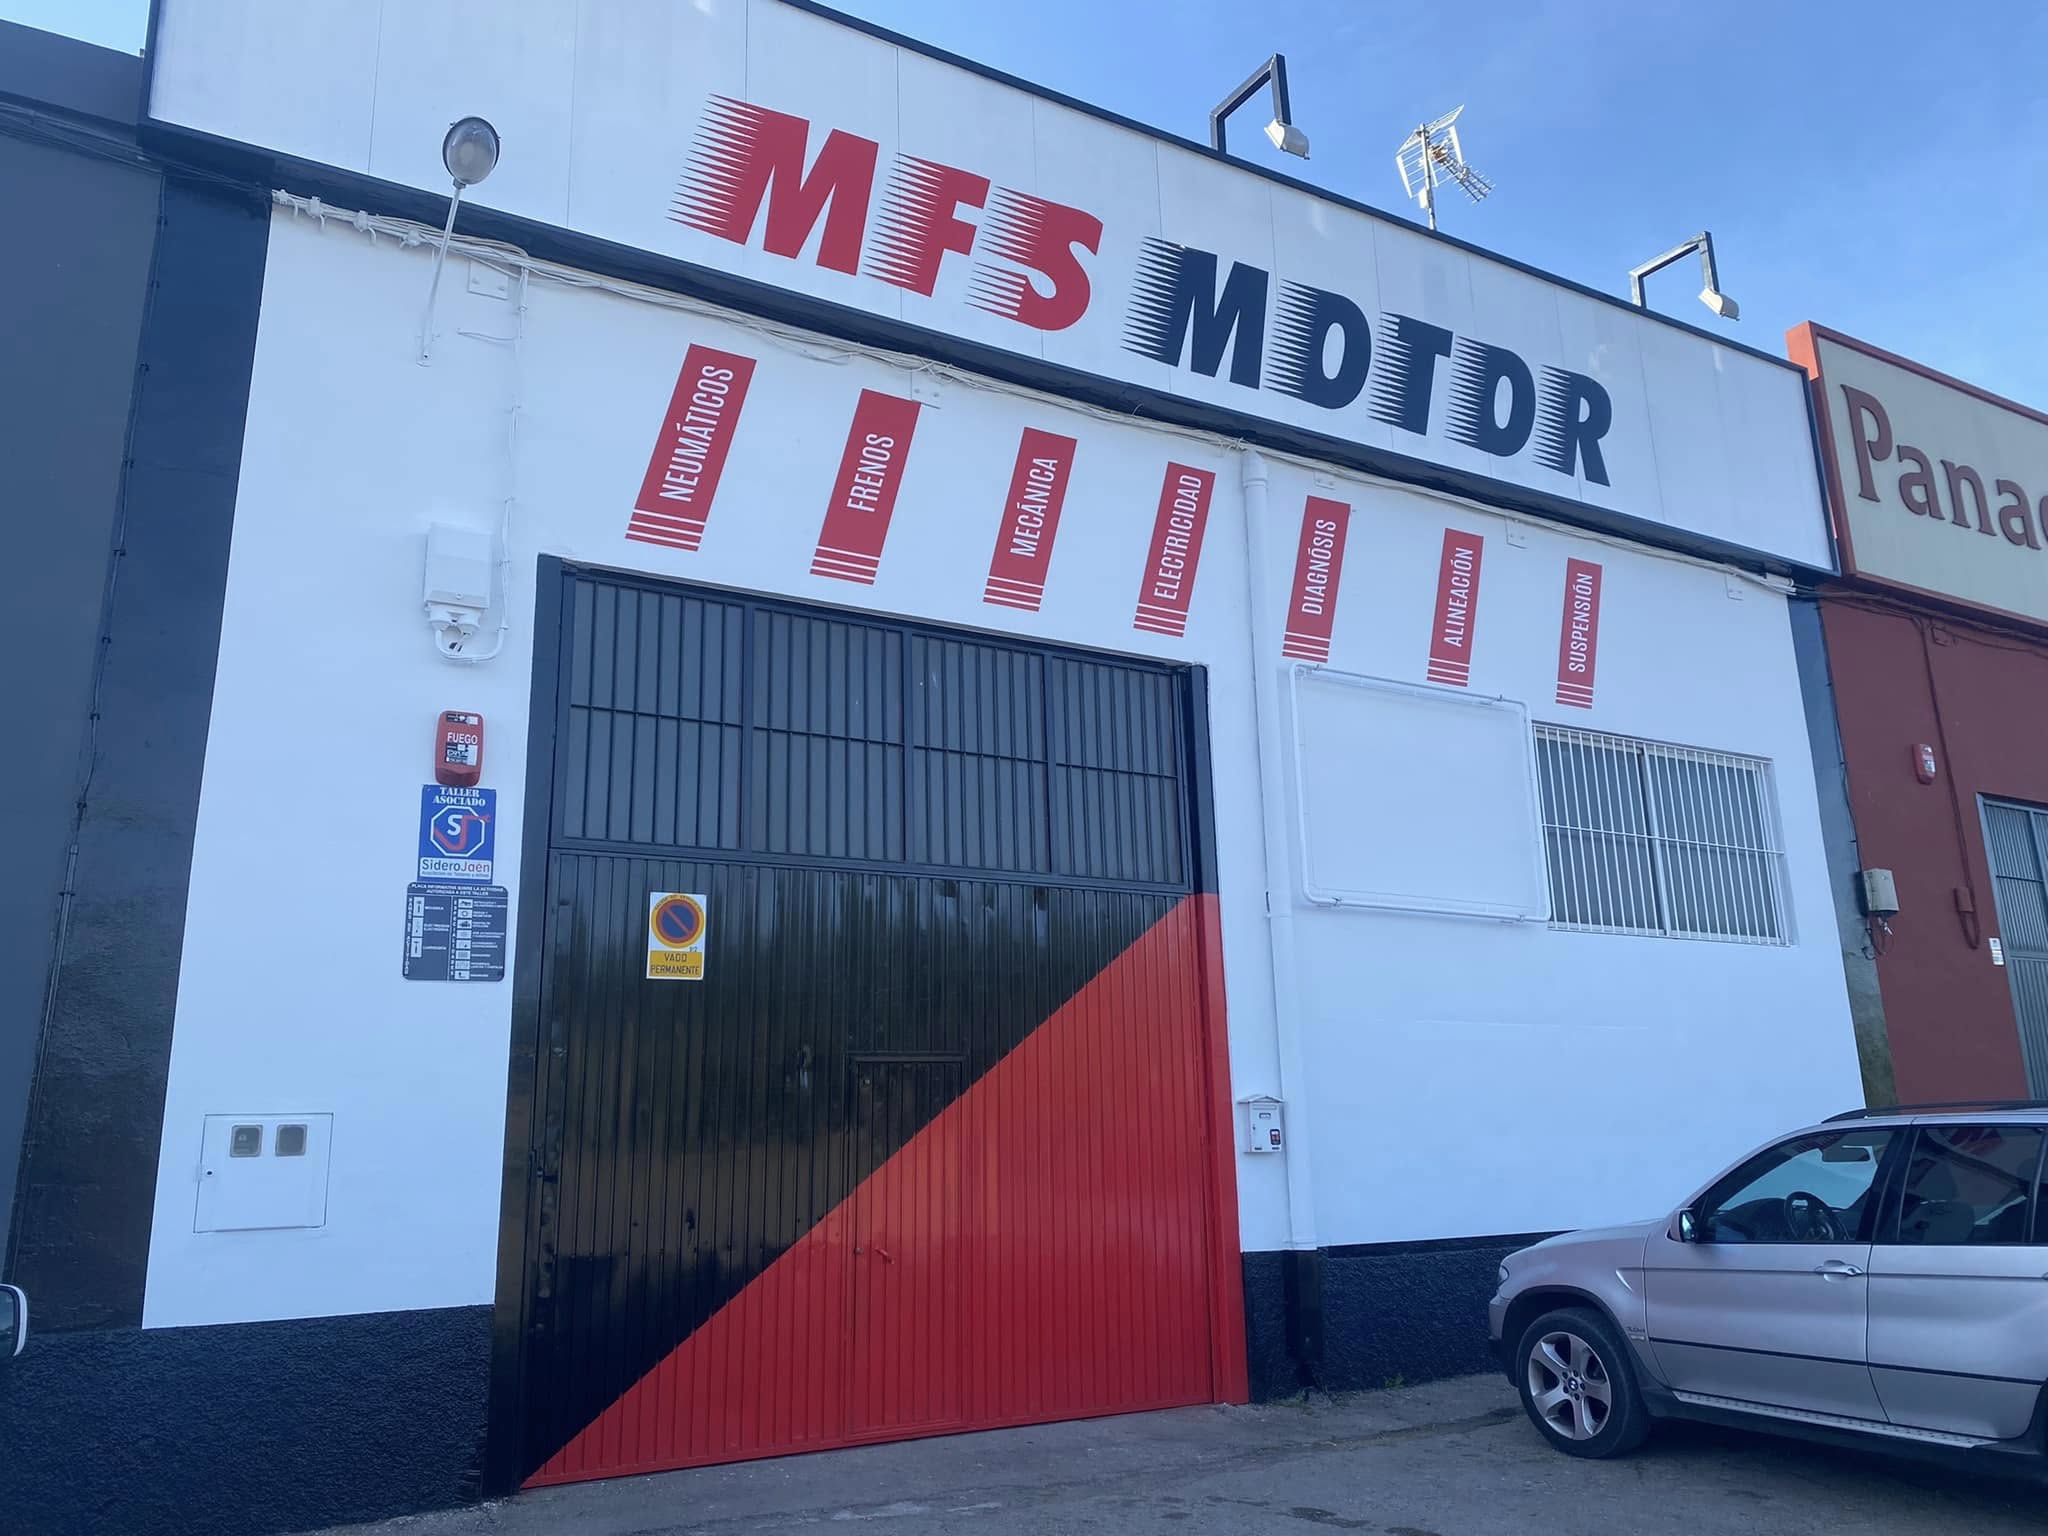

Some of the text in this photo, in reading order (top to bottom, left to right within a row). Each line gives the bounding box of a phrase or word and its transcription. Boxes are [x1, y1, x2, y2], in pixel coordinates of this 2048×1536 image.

[664, 92, 1612, 487] MFS MOTOR
[659, 365, 734, 502] NEUMÁTICOS
[847, 433, 895, 512] FRENOS
[1010, 458, 1058, 557] MECÁNICA
[1154, 474, 1202, 600] ELECTRICIDAD
[1302, 519, 1337, 615] DIAGNÓSIS
[1444, 547, 1474, 647] ALINEACIÓN
[1568, 573, 1593, 672] SUSPENSIÓN
[447, 732, 478, 745] FUEGO
[432, 795, 486, 806] ASOCIADO
[440, 787, 480, 797] TALLER
[651, 964, 700, 975] PERMANENTE
[664, 953, 688, 962] VADO
